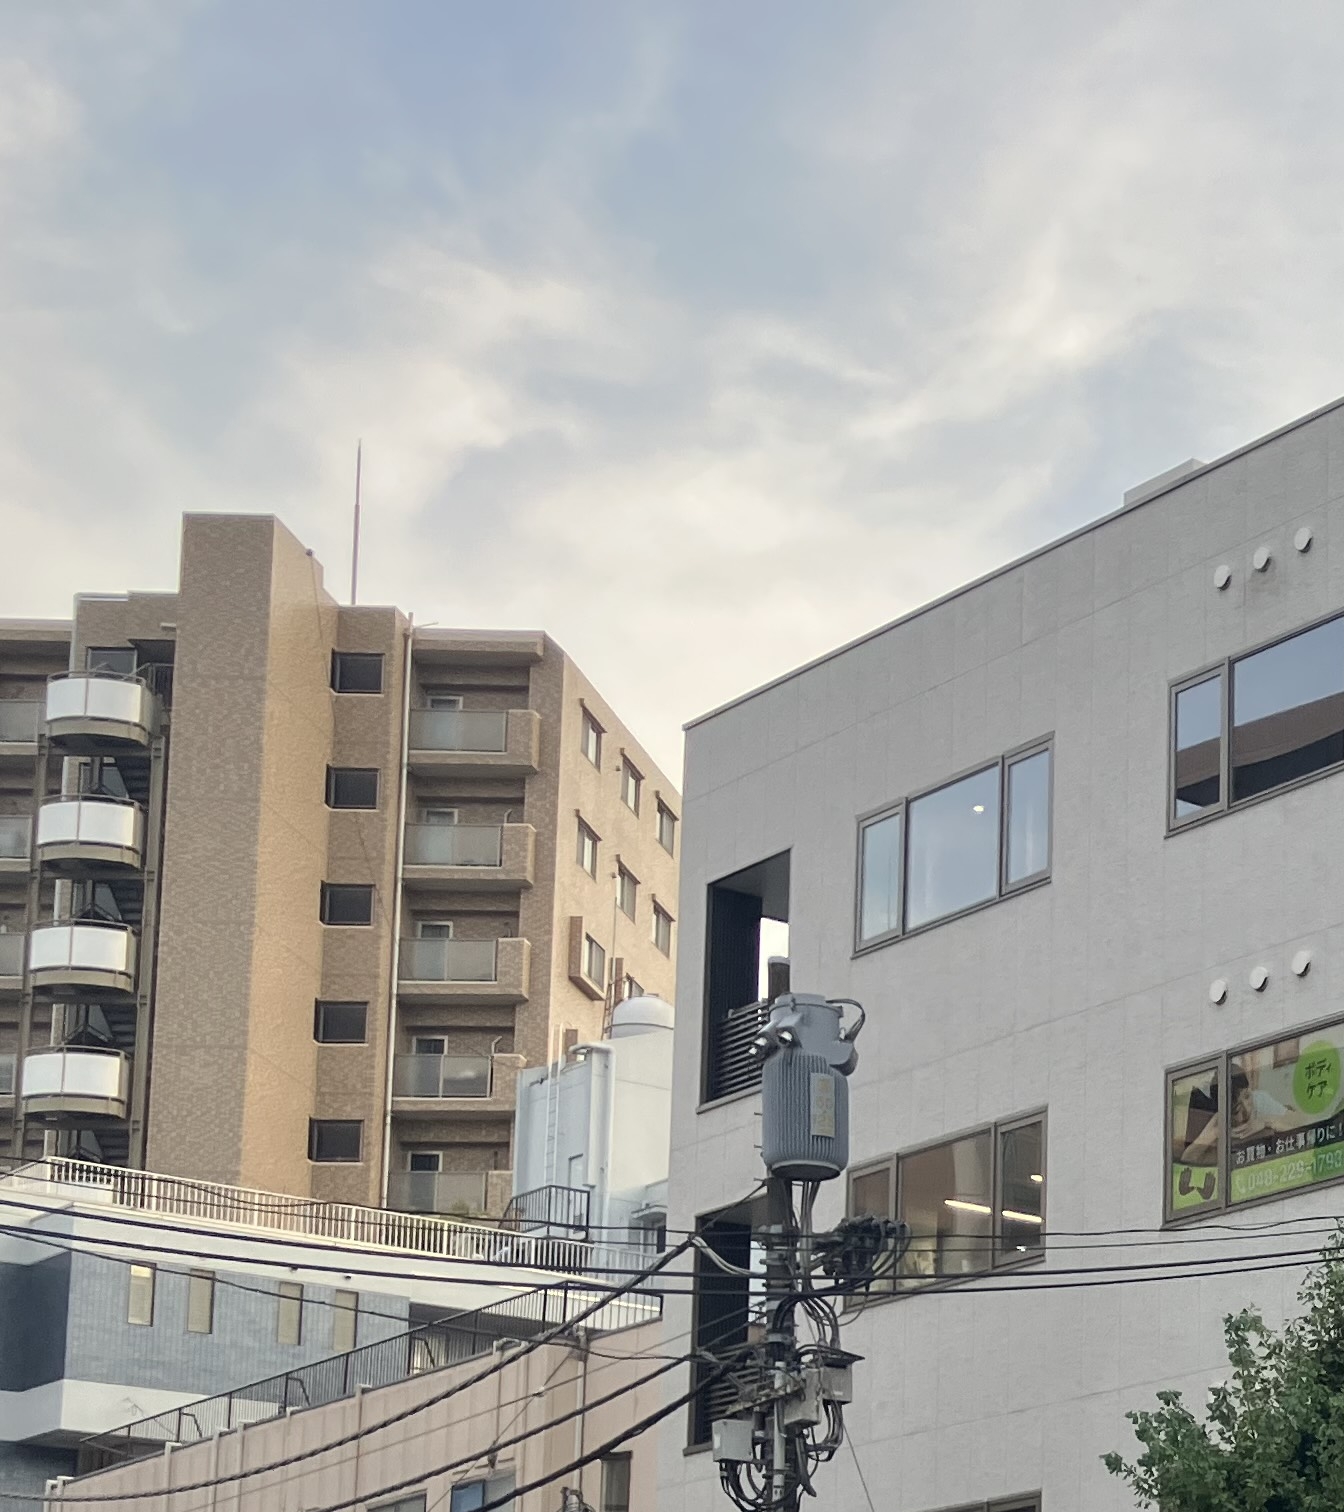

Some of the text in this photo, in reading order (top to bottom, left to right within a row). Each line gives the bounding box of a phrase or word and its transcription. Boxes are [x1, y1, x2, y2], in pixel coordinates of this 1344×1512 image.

[1305, 1058, 1332, 1080] ボディ
[1306, 1081, 1328, 1099] ケア
